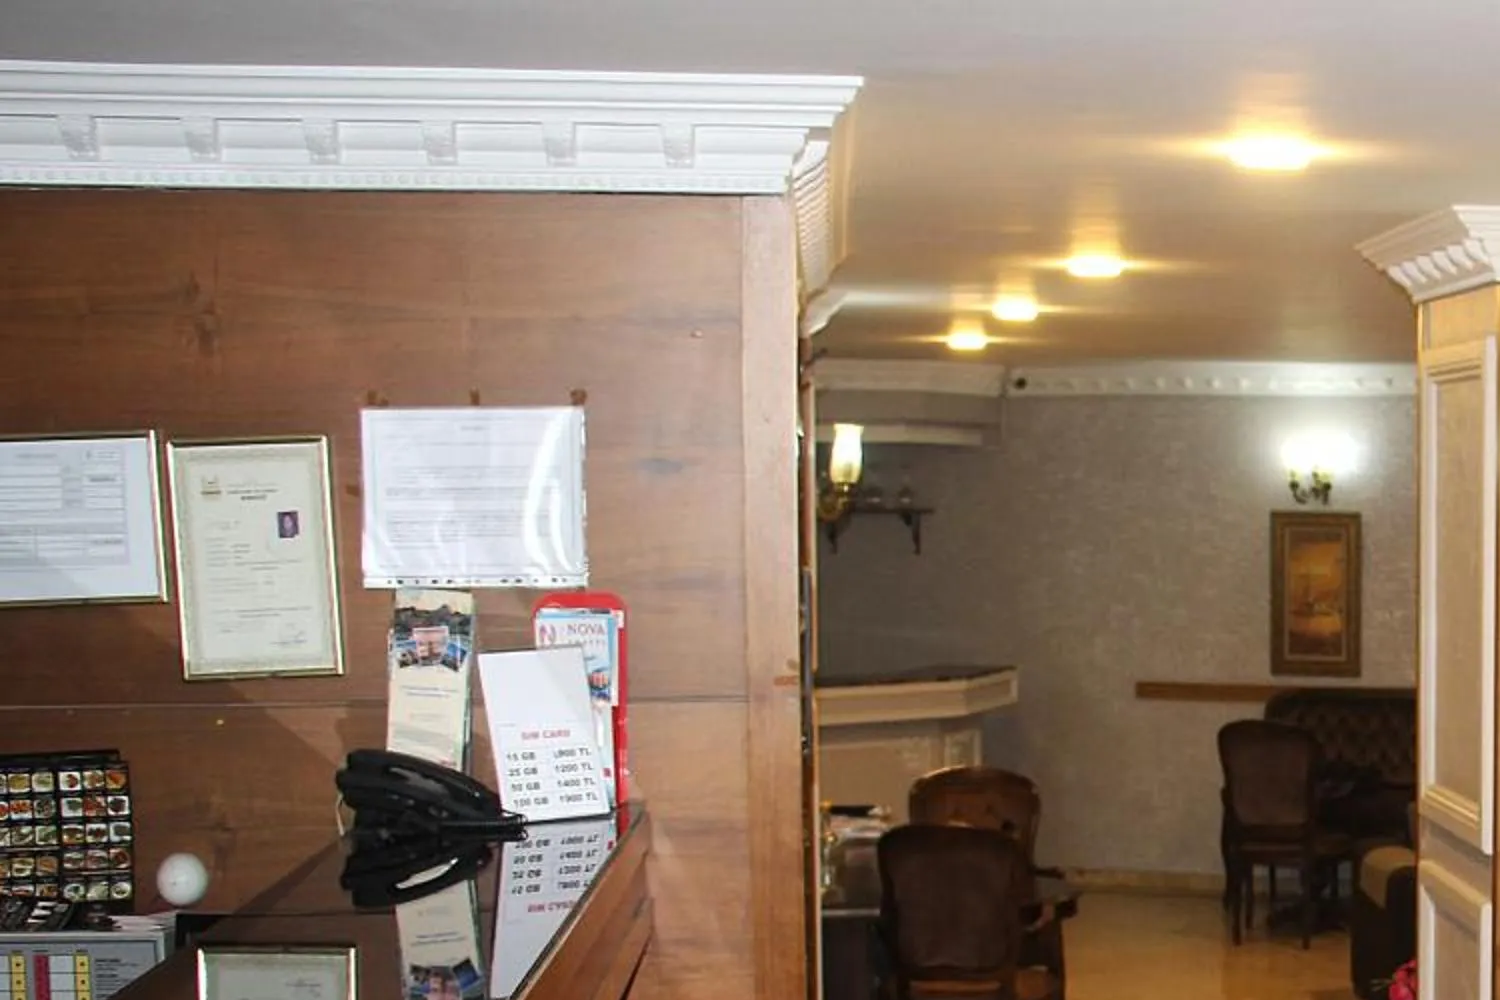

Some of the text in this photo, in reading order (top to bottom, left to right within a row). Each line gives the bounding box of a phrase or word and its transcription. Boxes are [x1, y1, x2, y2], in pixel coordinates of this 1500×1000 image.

[567, 623, 606, 636] NOVA
[521, 729, 571, 740] SIM CARD
[521, 751, 536, 761] GB
[578, 746, 592, 757] TL
[523, 766, 538, 776] GB
[581, 761, 594, 771] TL
[526, 781, 541, 791] GB
[583, 777, 596, 786] TL
[533, 796, 549, 805] GB
[585, 791, 598, 801] TL
